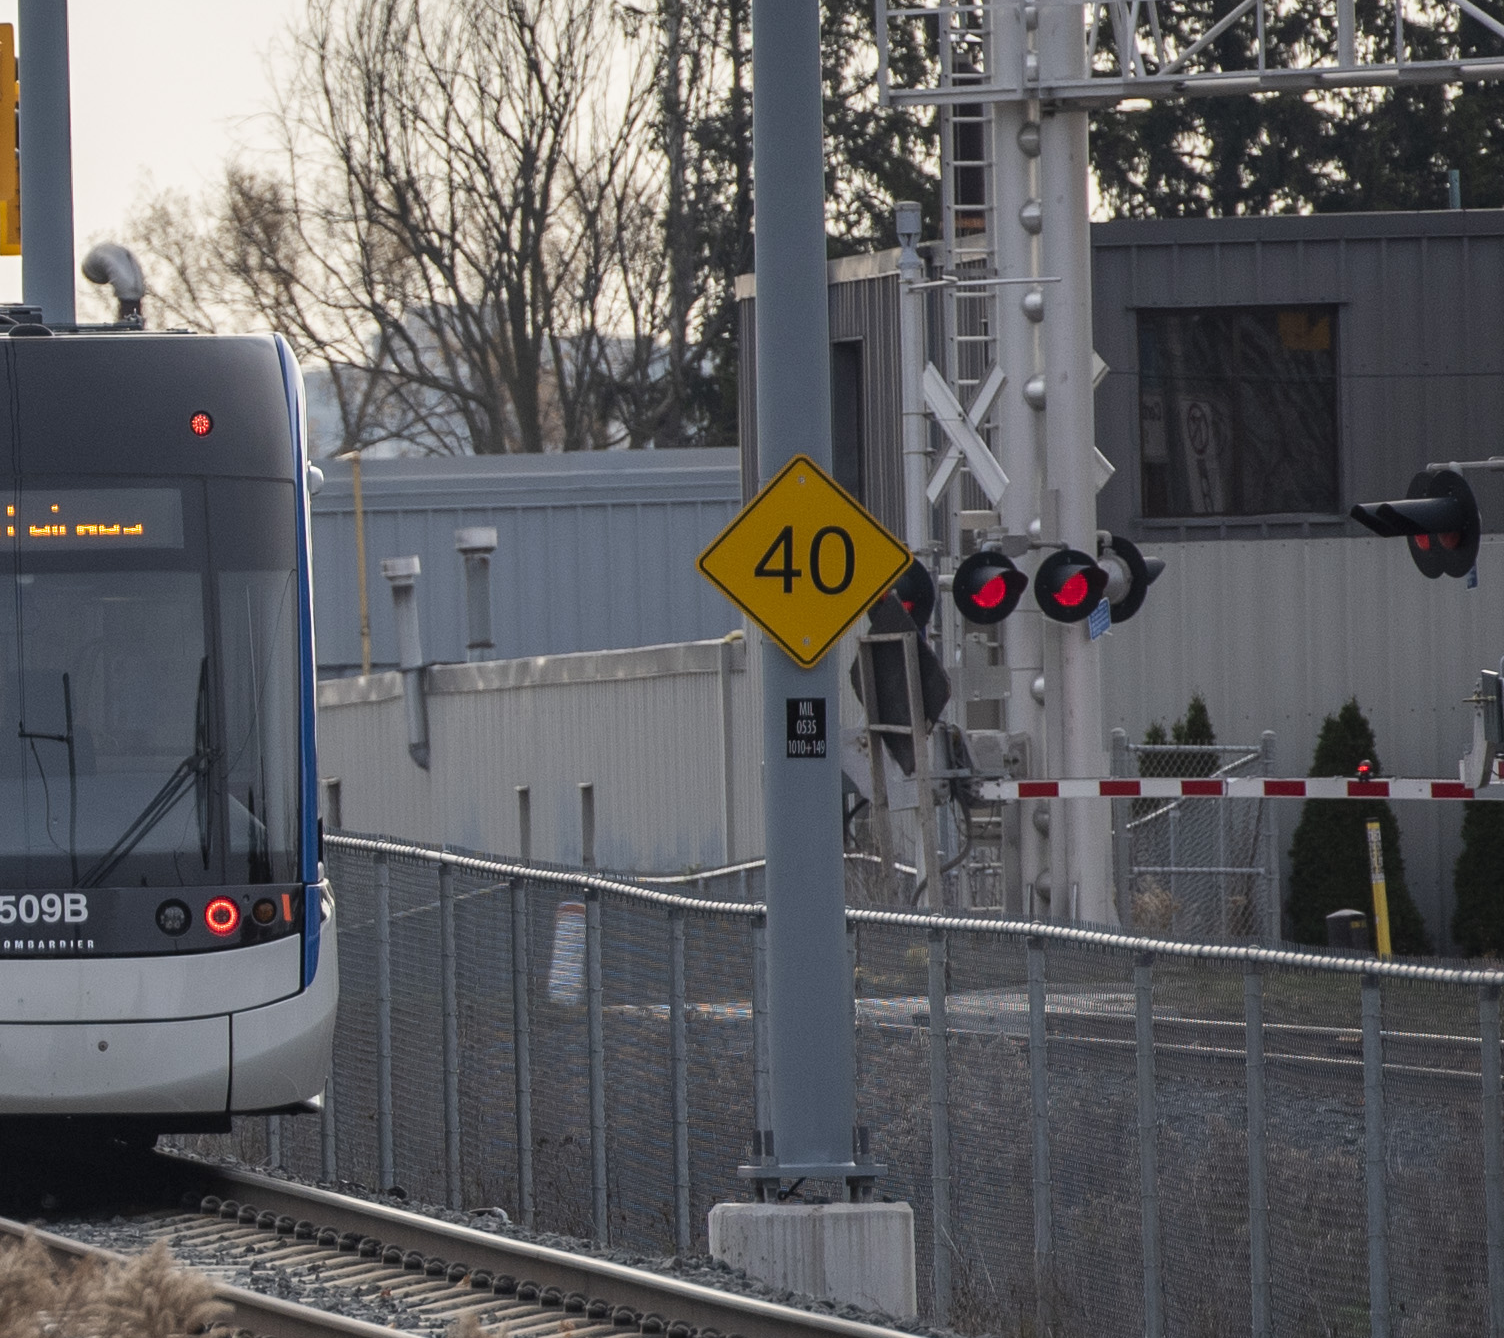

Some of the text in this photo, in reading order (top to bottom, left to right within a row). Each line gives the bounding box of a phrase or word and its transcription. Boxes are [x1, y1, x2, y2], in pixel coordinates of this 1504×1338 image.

[754, 525, 855, 595] 40
[799, 701, 814, 716] MIL
[796, 720, 817, 735] 0535
[788, 739, 825, 755] 1010+149
